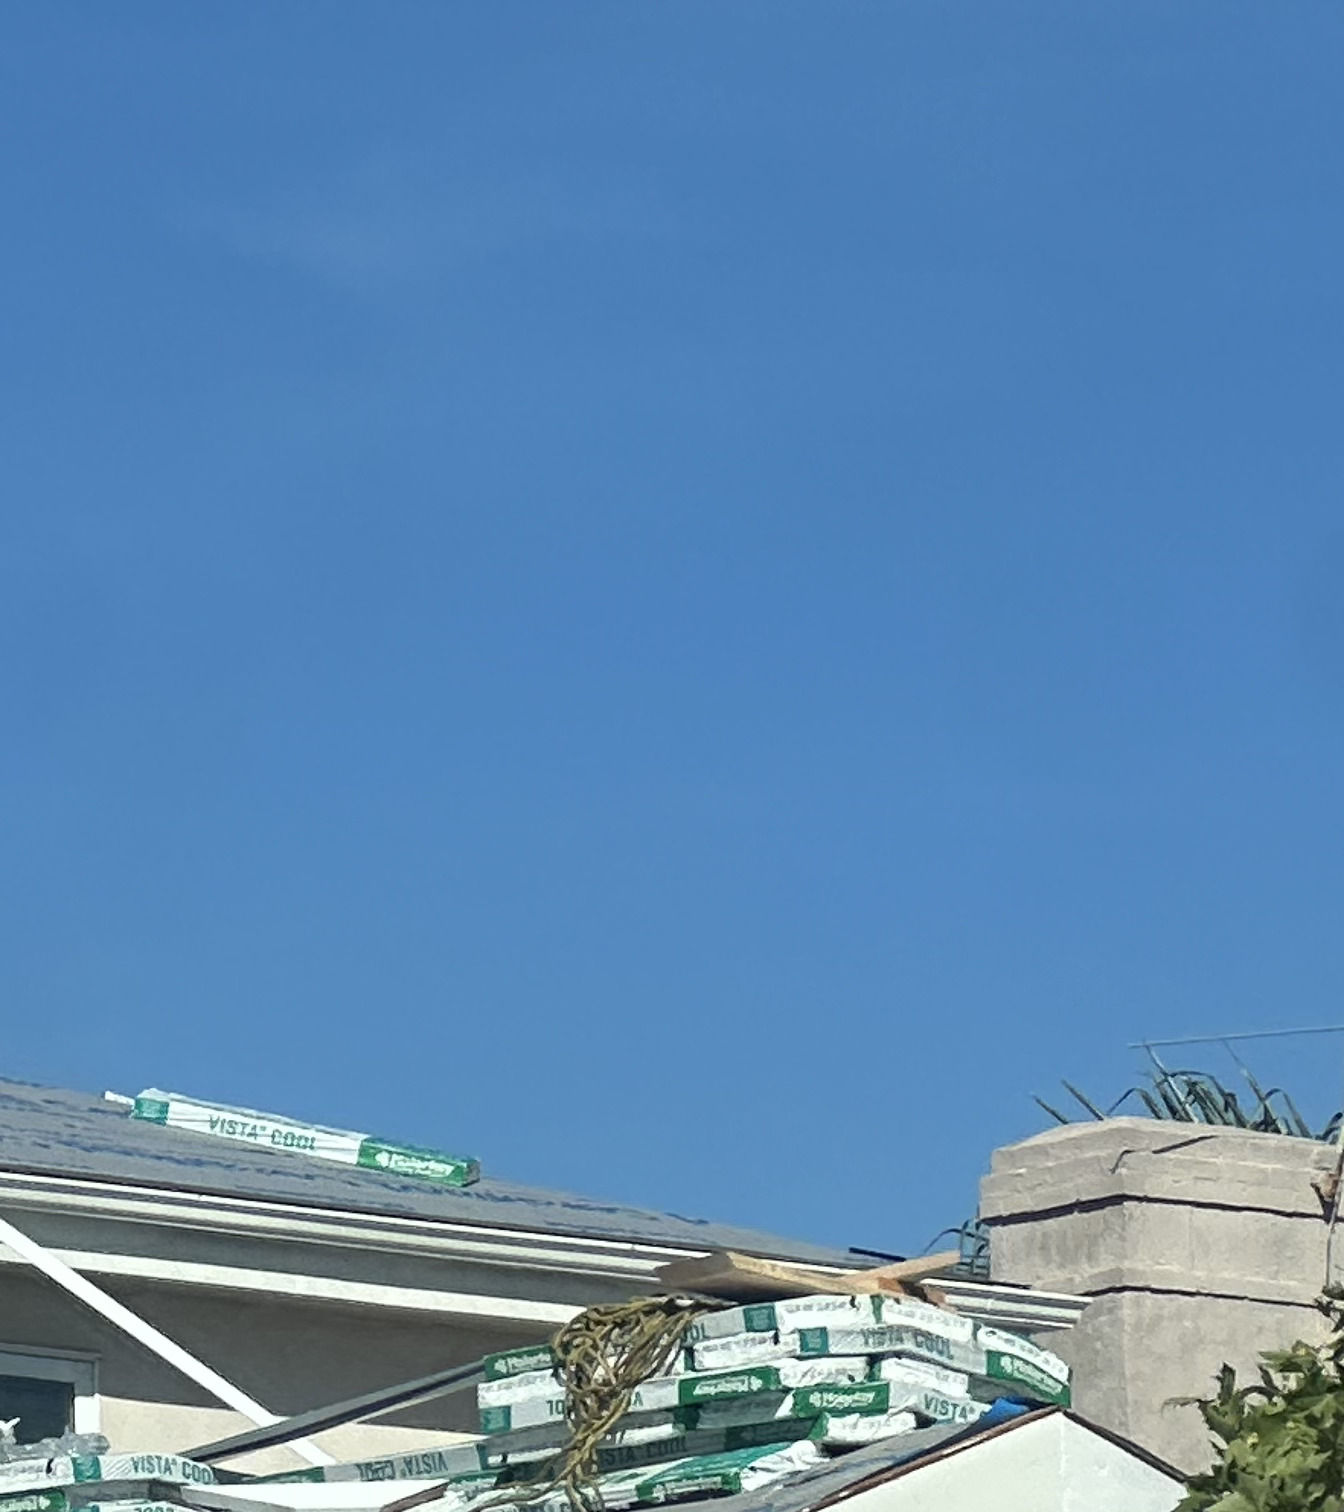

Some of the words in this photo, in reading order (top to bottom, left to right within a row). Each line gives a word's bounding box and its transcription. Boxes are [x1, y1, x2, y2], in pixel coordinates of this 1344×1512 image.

[208, 1114, 261, 1140] VISTA
[923, 1392, 970, 1421] VISTA
[130, 1455, 172, 1477] VISTA
